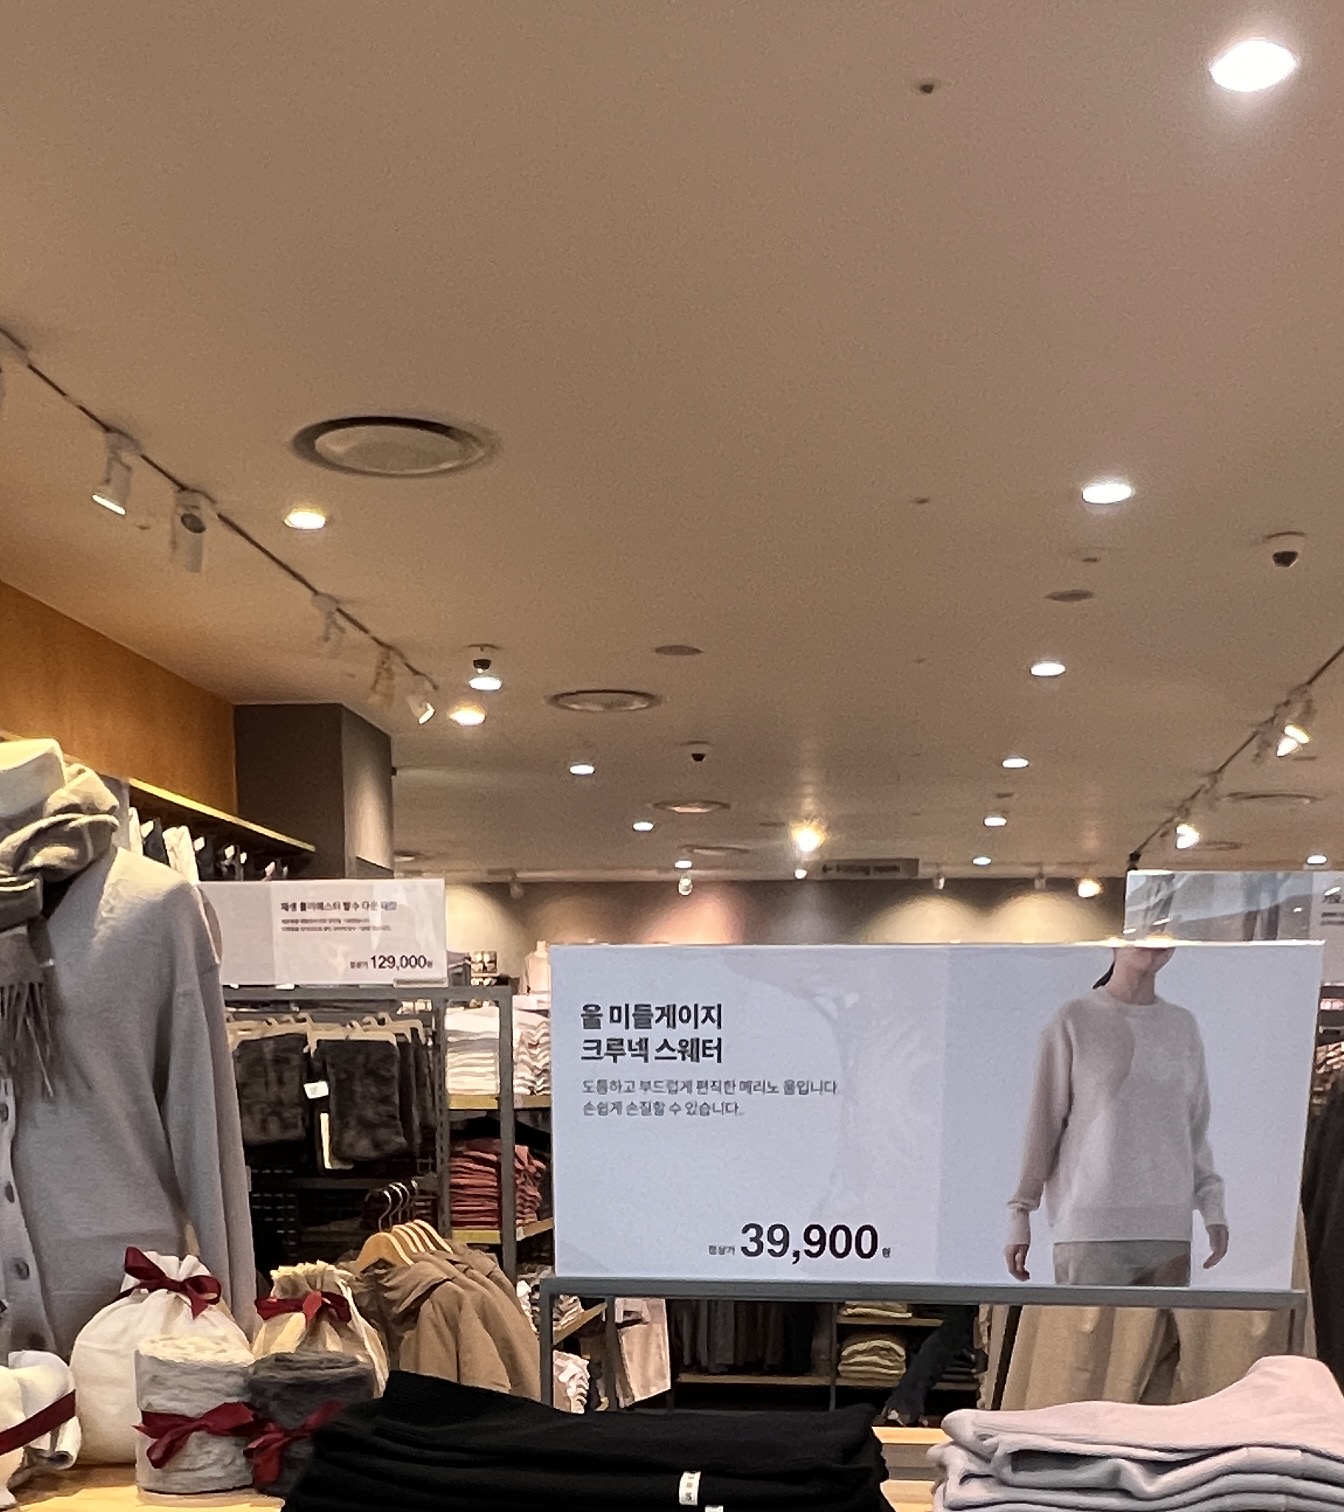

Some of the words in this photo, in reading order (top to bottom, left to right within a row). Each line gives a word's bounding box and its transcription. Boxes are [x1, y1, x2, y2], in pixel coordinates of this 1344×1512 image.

[581, 1003, 603, 1029] 울
[609, 1003, 722, 1029] 미들게이지
[581, 1037, 649, 1063] 크루넥
[654, 1037, 722, 1063] 스웨터
[583, 1079, 635, 1095] 도톰하고
[639, 1079, 693, 1096] 부드럽게
[696, 1079, 736, 1095] 편직한
[739, 1079, 780, 1095] 메리노
[583, 1101, 623, 1116] 손쉽게
[626, 1101, 665, 1116] 손질할
[668, 1102, 682, 1116] 수
